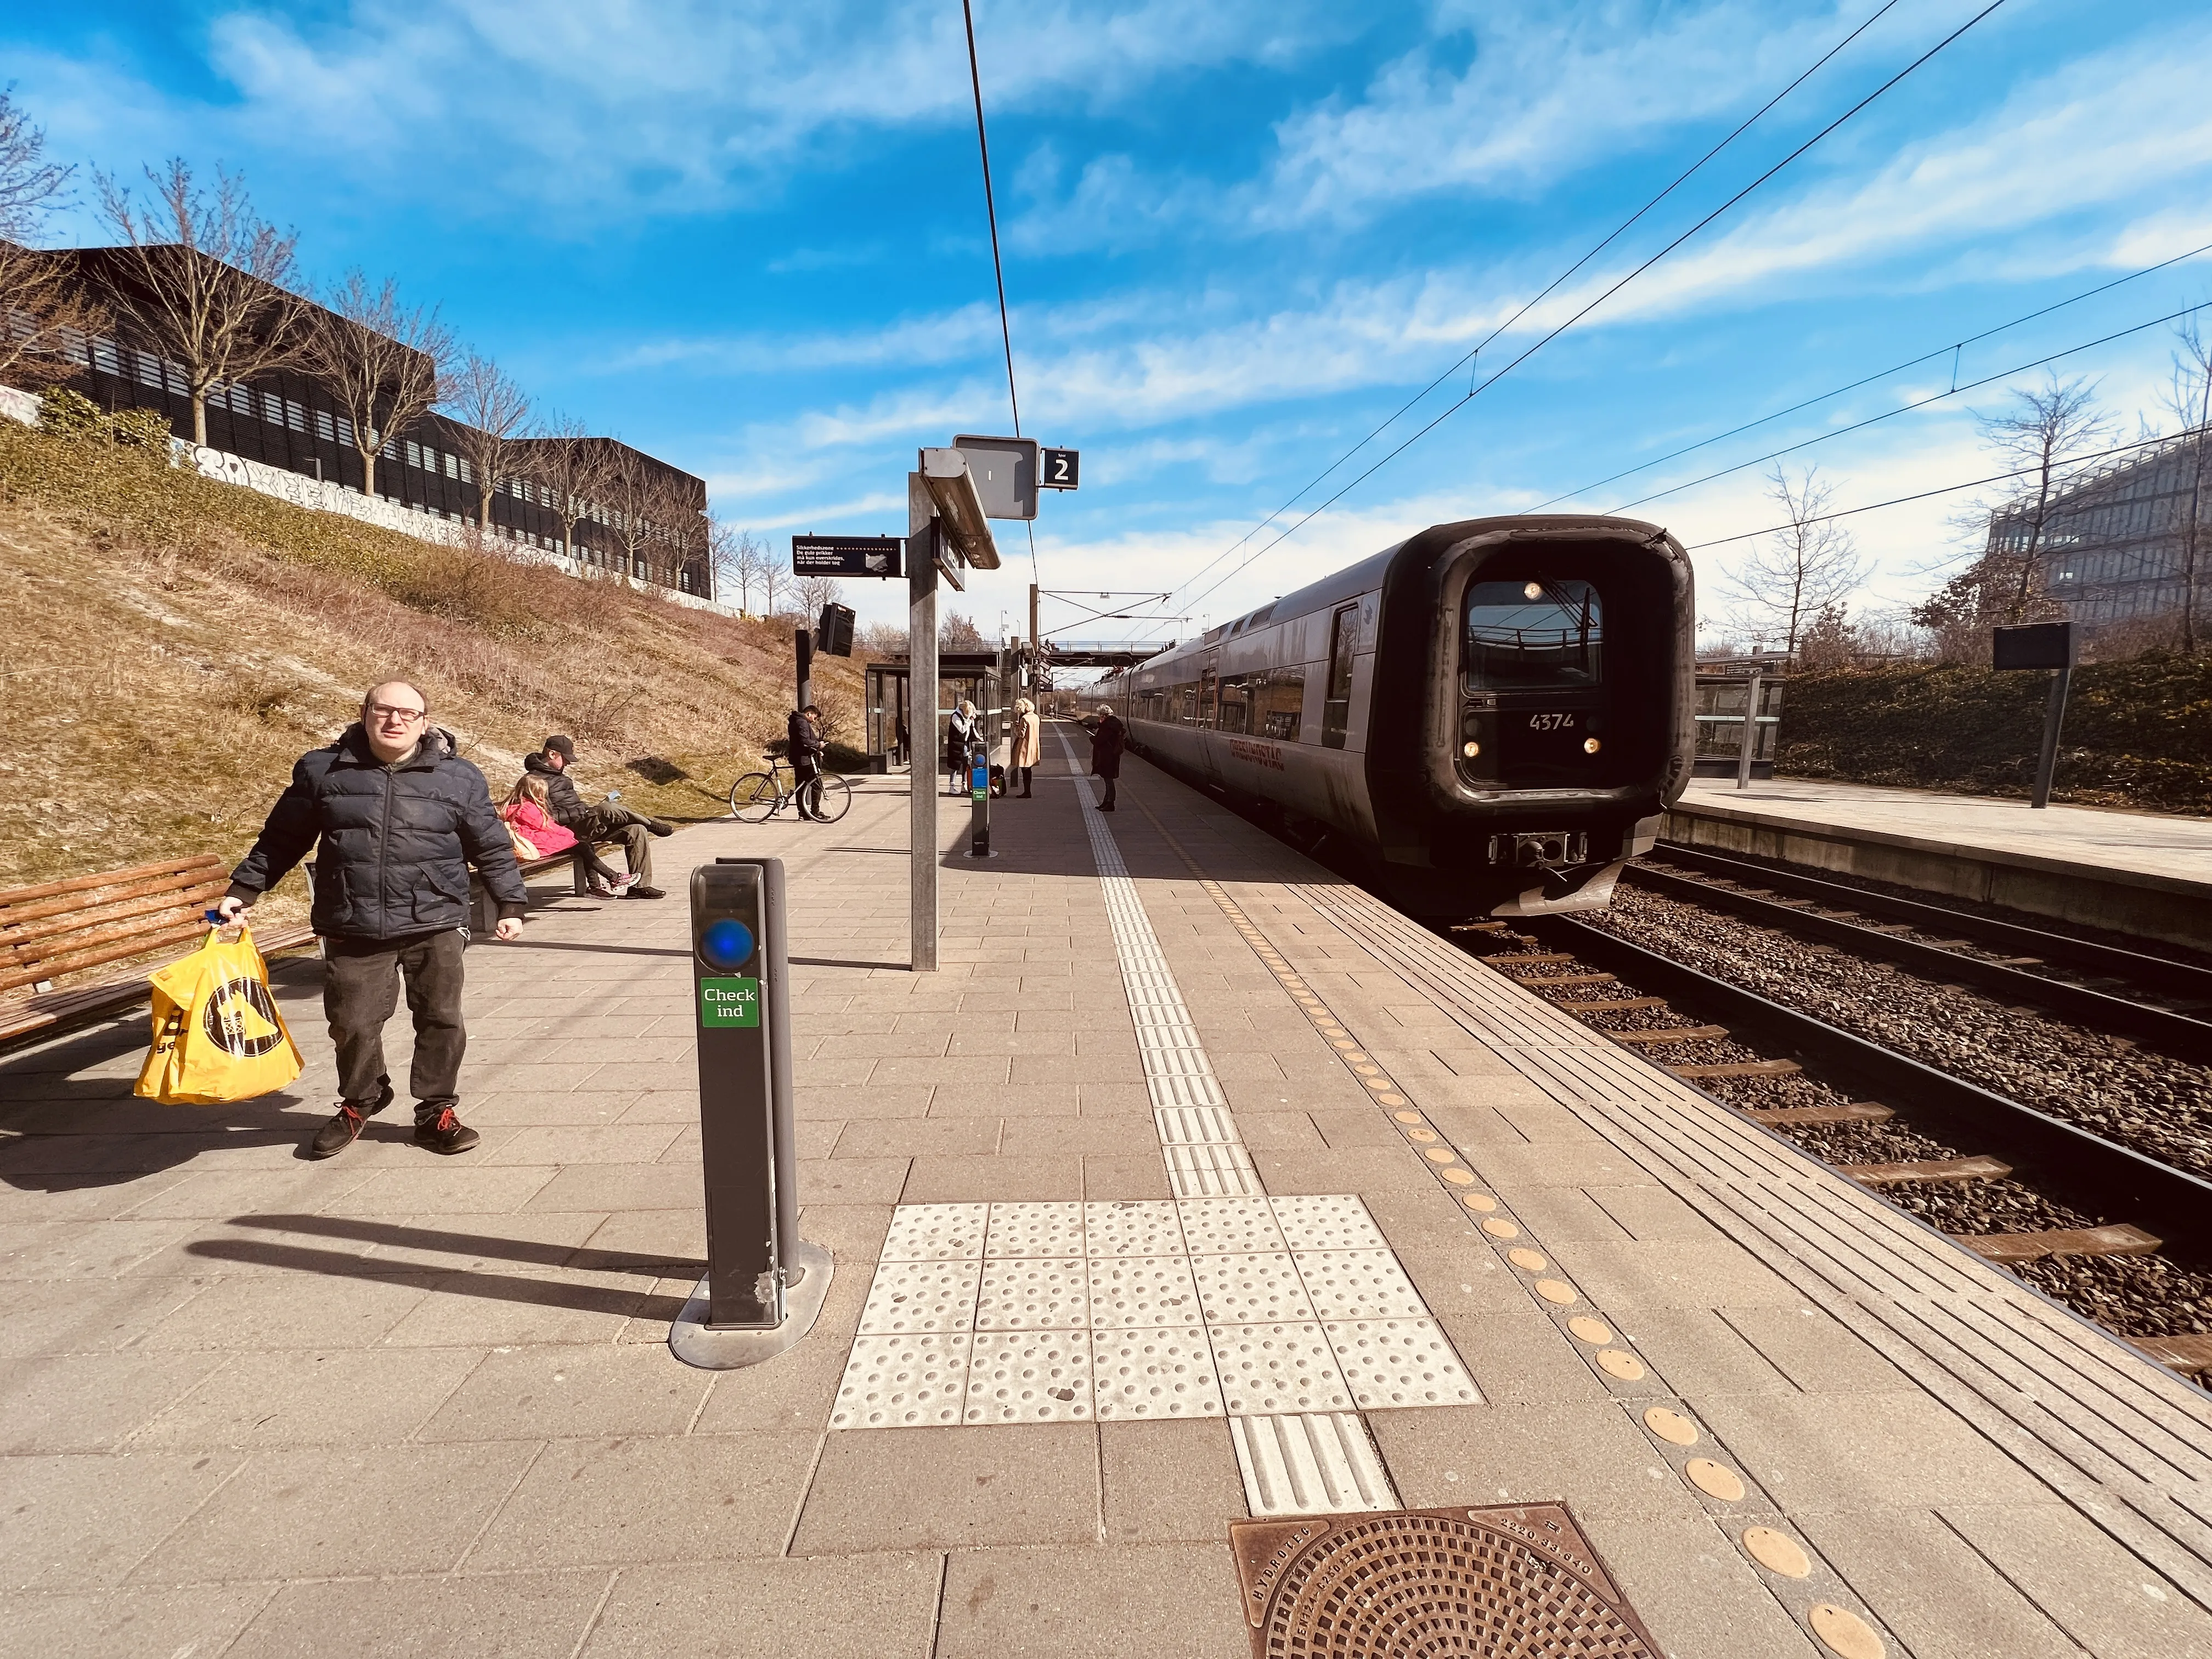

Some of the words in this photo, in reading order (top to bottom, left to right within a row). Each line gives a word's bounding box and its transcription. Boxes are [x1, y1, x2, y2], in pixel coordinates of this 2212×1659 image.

[1054, 459, 1069, 481] 2
[1530, 714, 1574, 730] 4374
[704, 989, 755, 1001] Check
[717, 1005, 744, 1017] ind
[1252, 1527, 1311, 1601] HYDROTEC
